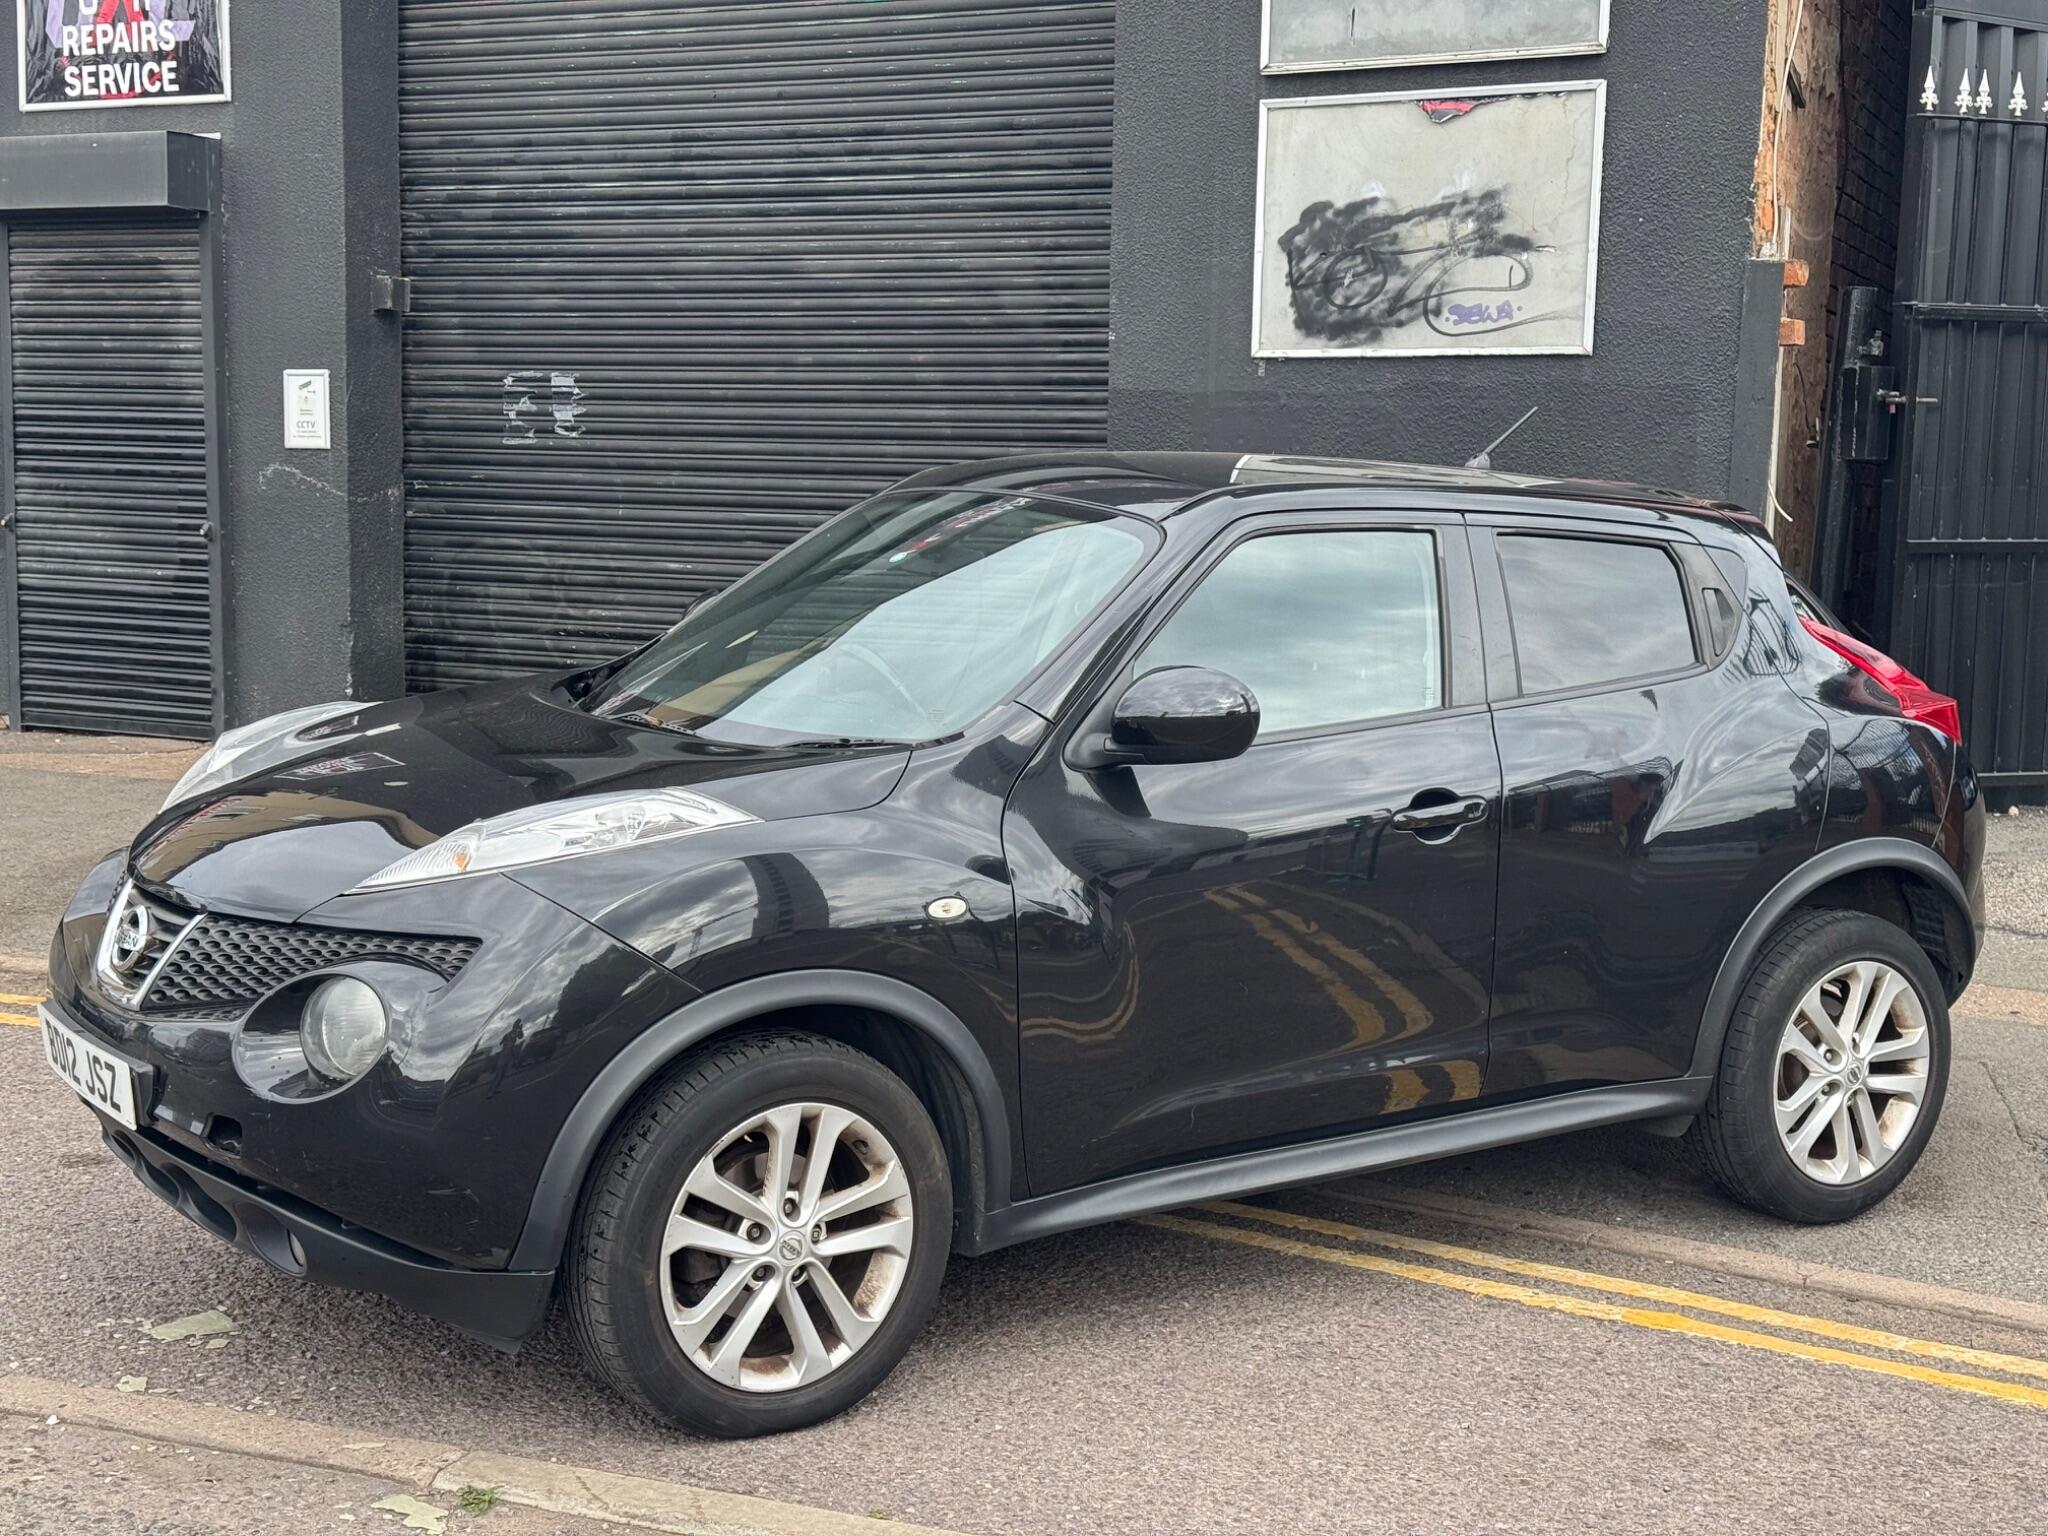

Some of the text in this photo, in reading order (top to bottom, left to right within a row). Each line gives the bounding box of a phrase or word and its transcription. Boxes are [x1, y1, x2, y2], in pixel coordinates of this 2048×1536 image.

[62, 19, 176, 57] REPAIRS
[64, 60, 179, 97] SERVICE
[296, 420, 316, 429] CCTV
[45, 1018, 121, 1113] BD12 JSZ
